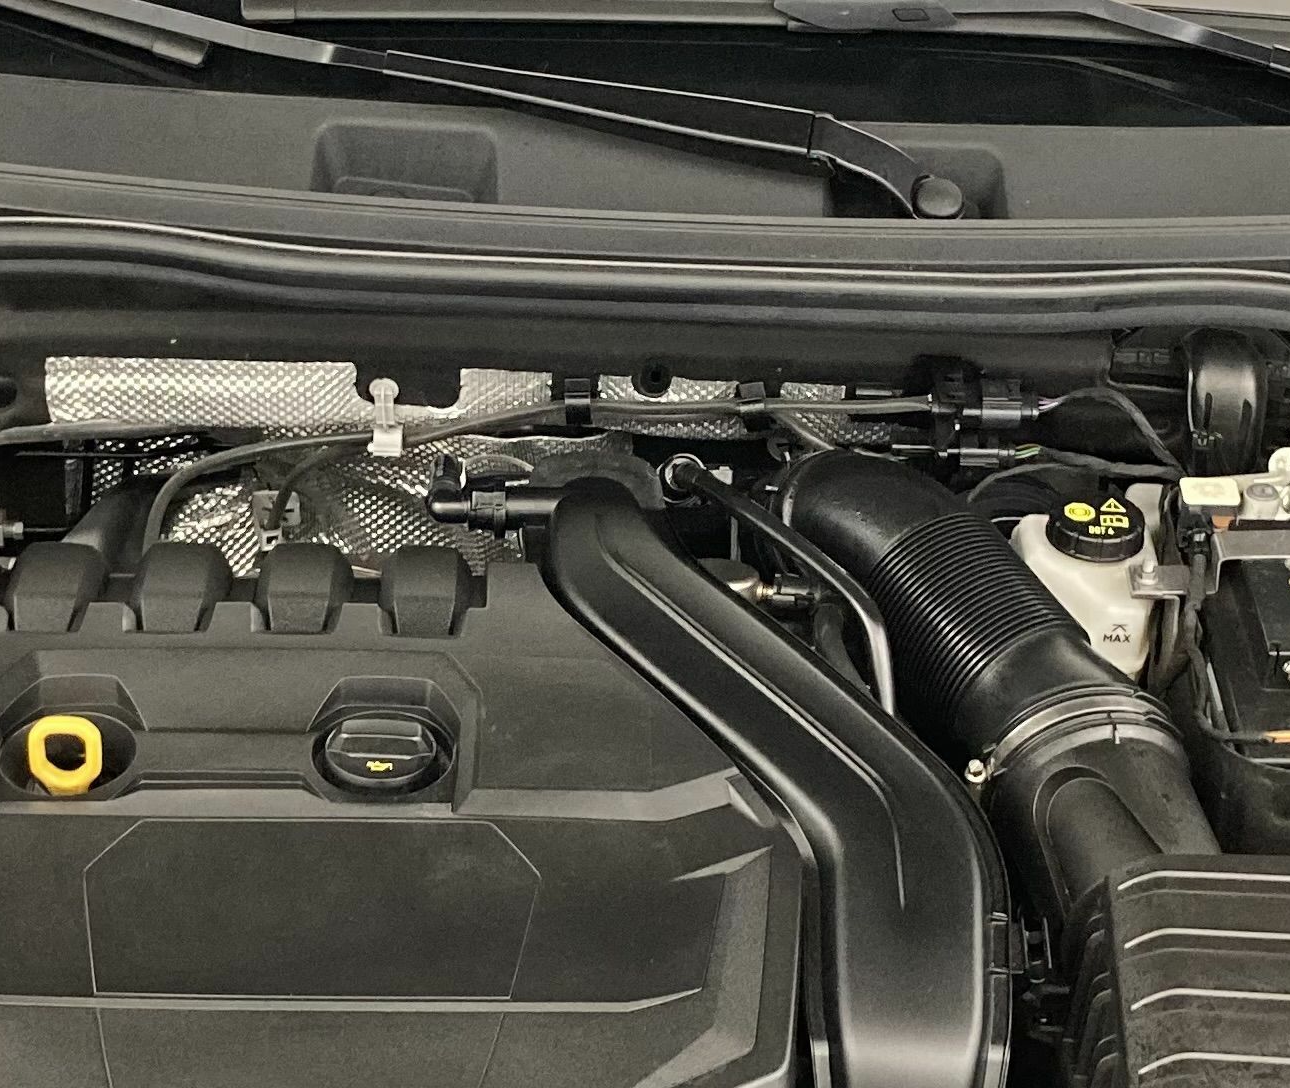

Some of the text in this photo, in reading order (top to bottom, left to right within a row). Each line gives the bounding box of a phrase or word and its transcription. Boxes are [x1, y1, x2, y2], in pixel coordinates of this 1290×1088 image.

[1088, 525, 1115, 535] DOT 4
[1103, 633, 1131, 643] MAX
